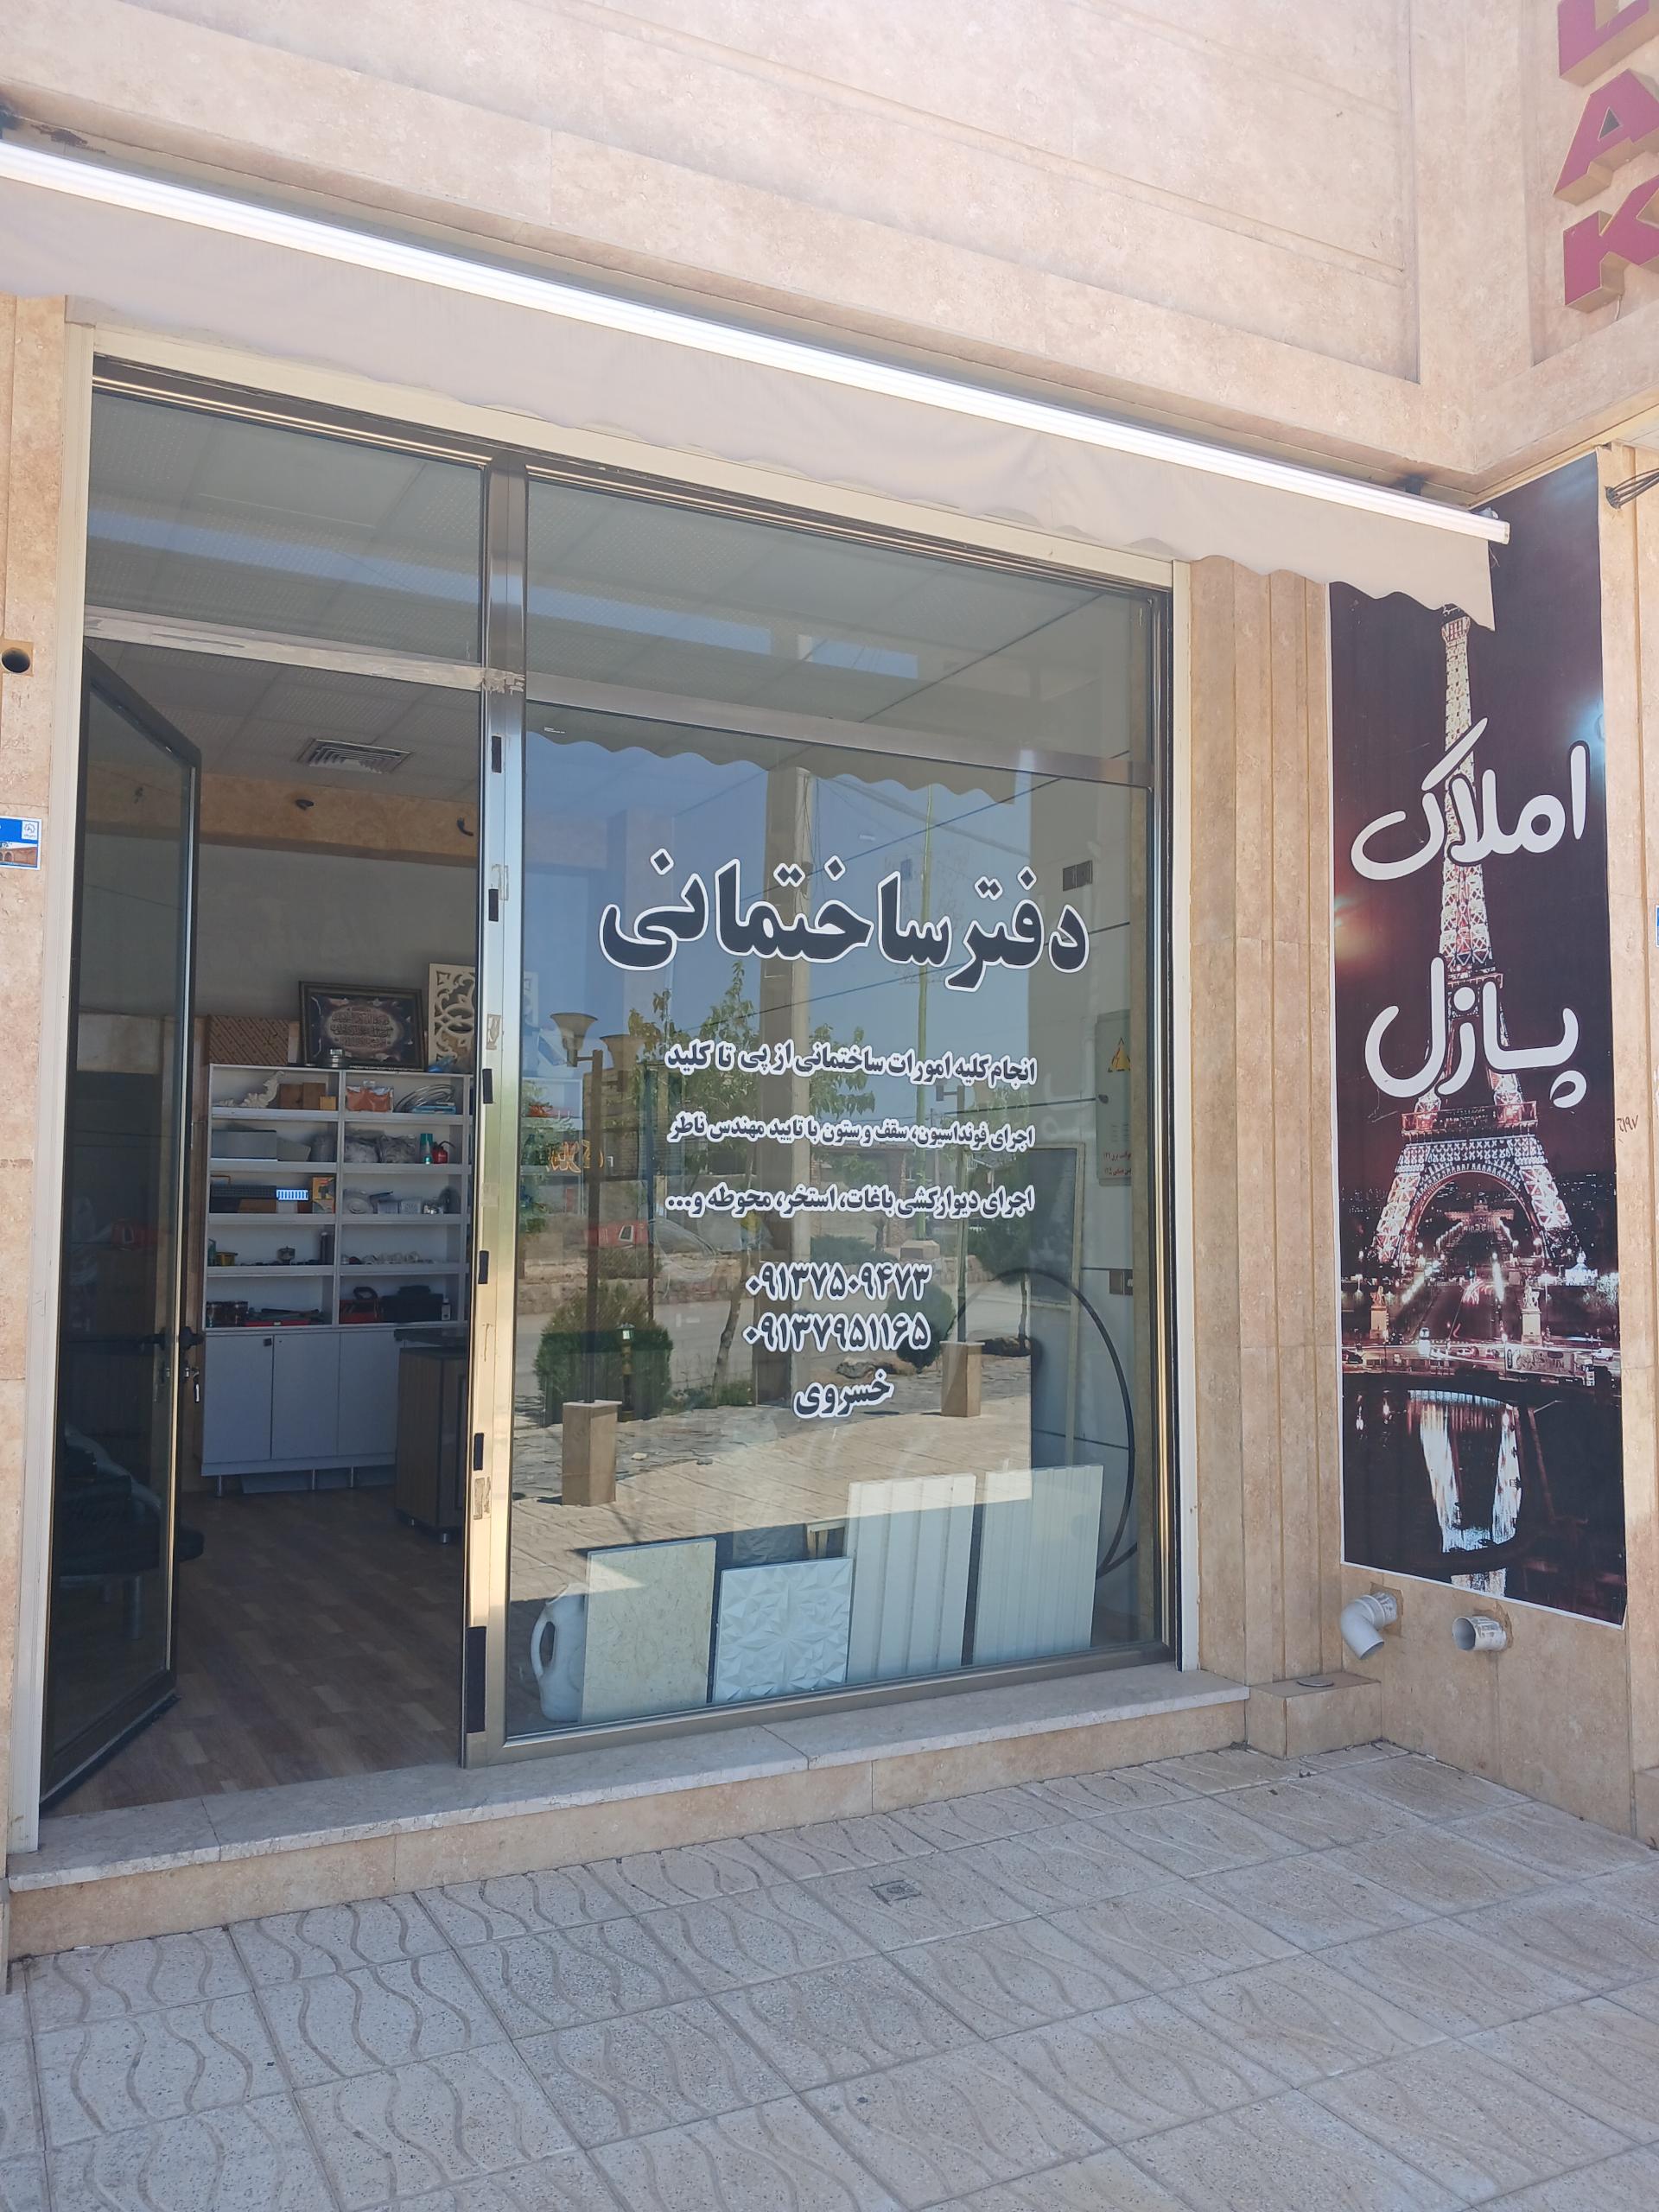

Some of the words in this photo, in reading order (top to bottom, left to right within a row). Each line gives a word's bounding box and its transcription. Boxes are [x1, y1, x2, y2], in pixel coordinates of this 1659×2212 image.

[1351, 717, 1587, 880] املاک
[599, 848, 950, 971] ساختمانی
[944, 864, 1090, 992] دفتر
[664, 1039, 715, 1076] کلید
[715, 1039, 735, 1071] تا
[738, 1042, 771, 1076] پی
[770, 1039, 795, 1076] از
[792, 1041, 887, 1077] ساختمانی
[887, 1047, 953, 1086] امورات
[953, 1052, 992, 1087] کلیه
[988, 1054, 1037, 1090] انجام
[708, 1116, 766, 1141] مهندس
[768, 1114, 804, 1144] تایید
[805, 1115, 820, 1145] با
[819, 1119, 861, 1147] ستون
[859, 1122, 874, 1147] و
[874, 1118, 909, 1141] سقف
[988, 1123, 1036, 1153] اجرای
[706, 1181, 773, 1218] محوطه
[980, 1184, 1036, 1219] اجرای
[745, 1261, 933, 1301] ۰۹۱۳۷۵۰۹۴۷۳
[742, 1311, 931, 1352] ۰۹۱۳۷۹۵۱۱۶۵
[793, 1368, 895, 1419] خسروی
